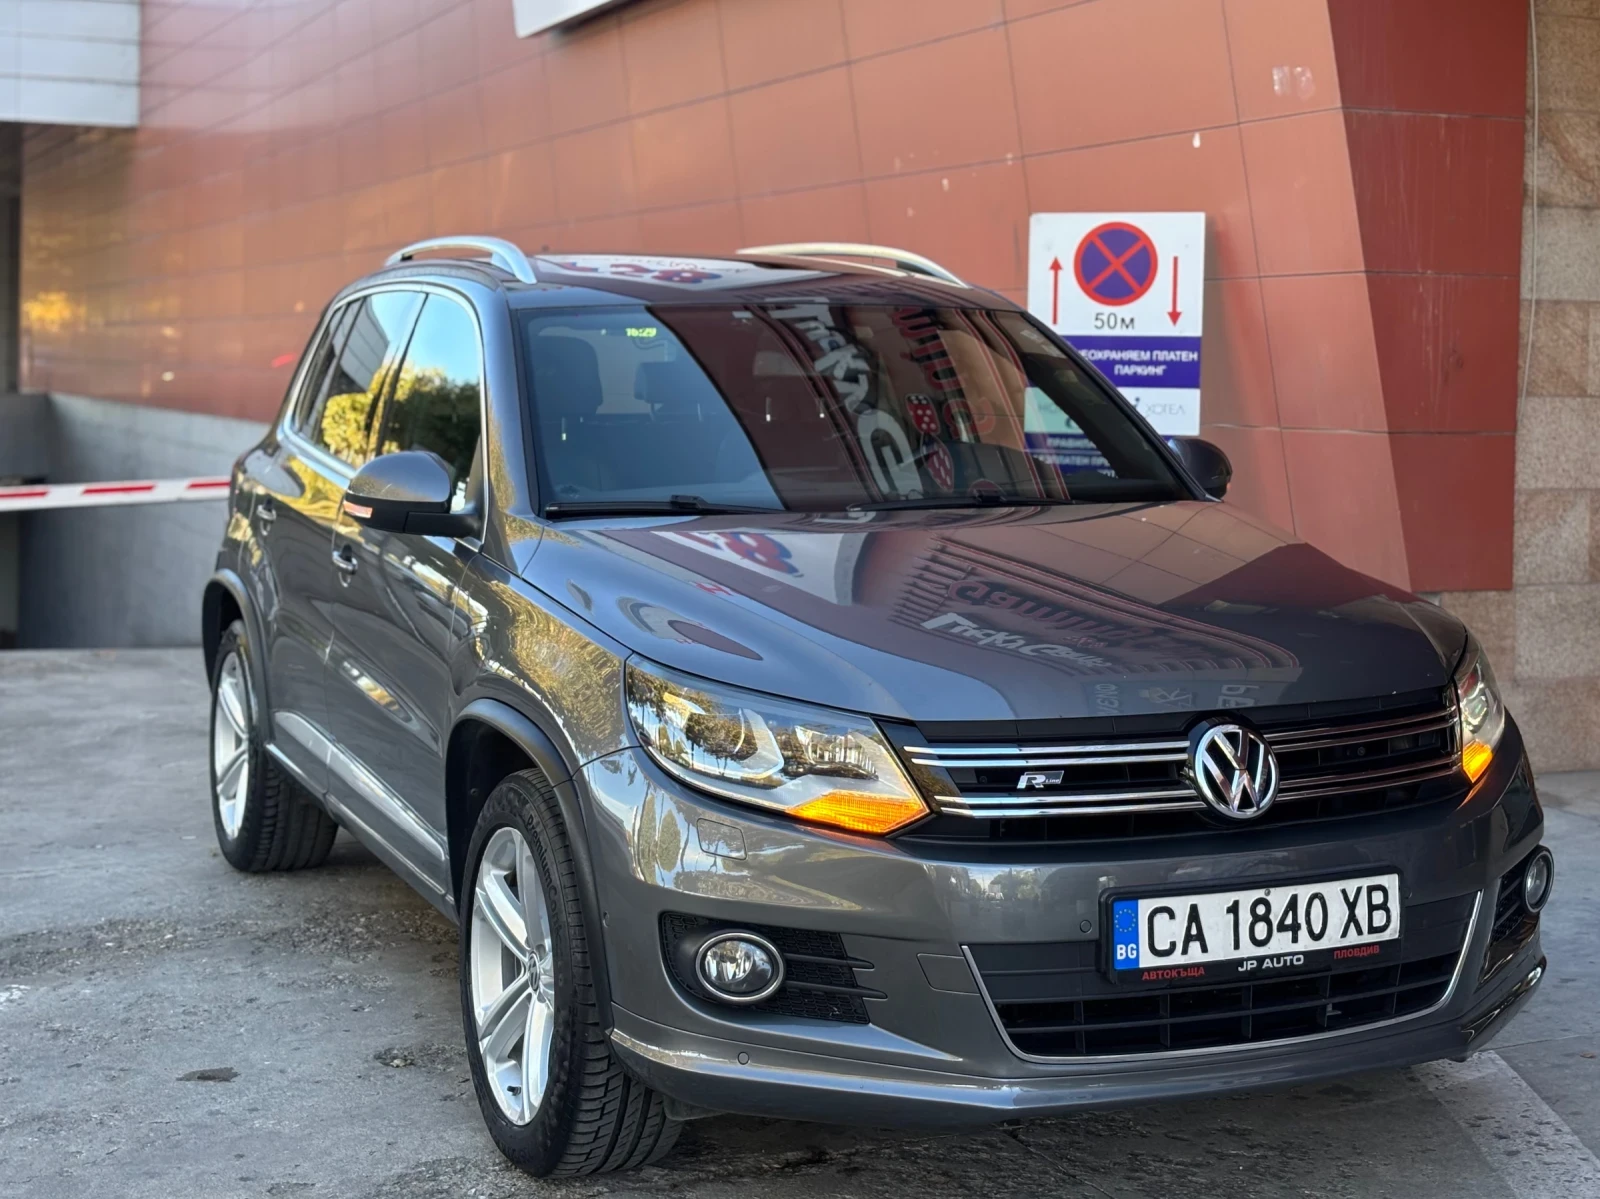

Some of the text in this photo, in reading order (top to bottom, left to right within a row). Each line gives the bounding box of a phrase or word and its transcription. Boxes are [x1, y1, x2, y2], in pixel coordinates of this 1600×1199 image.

[1078, 349, 1198, 362] ЕОХРАНЯЕМ ПЛАТЕН
[1114, 364, 1168, 376] ПАРКИНГ
[1147, 884, 1392, 958] CA 1840 XB
[1116, 943, 1137, 960] BG
[1333, 945, 1380, 960] ПЛОВДИВ
[1237, 954, 1305, 972] JP AUTO
[1142, 966, 1205, 981] АВТОКЪЩА
